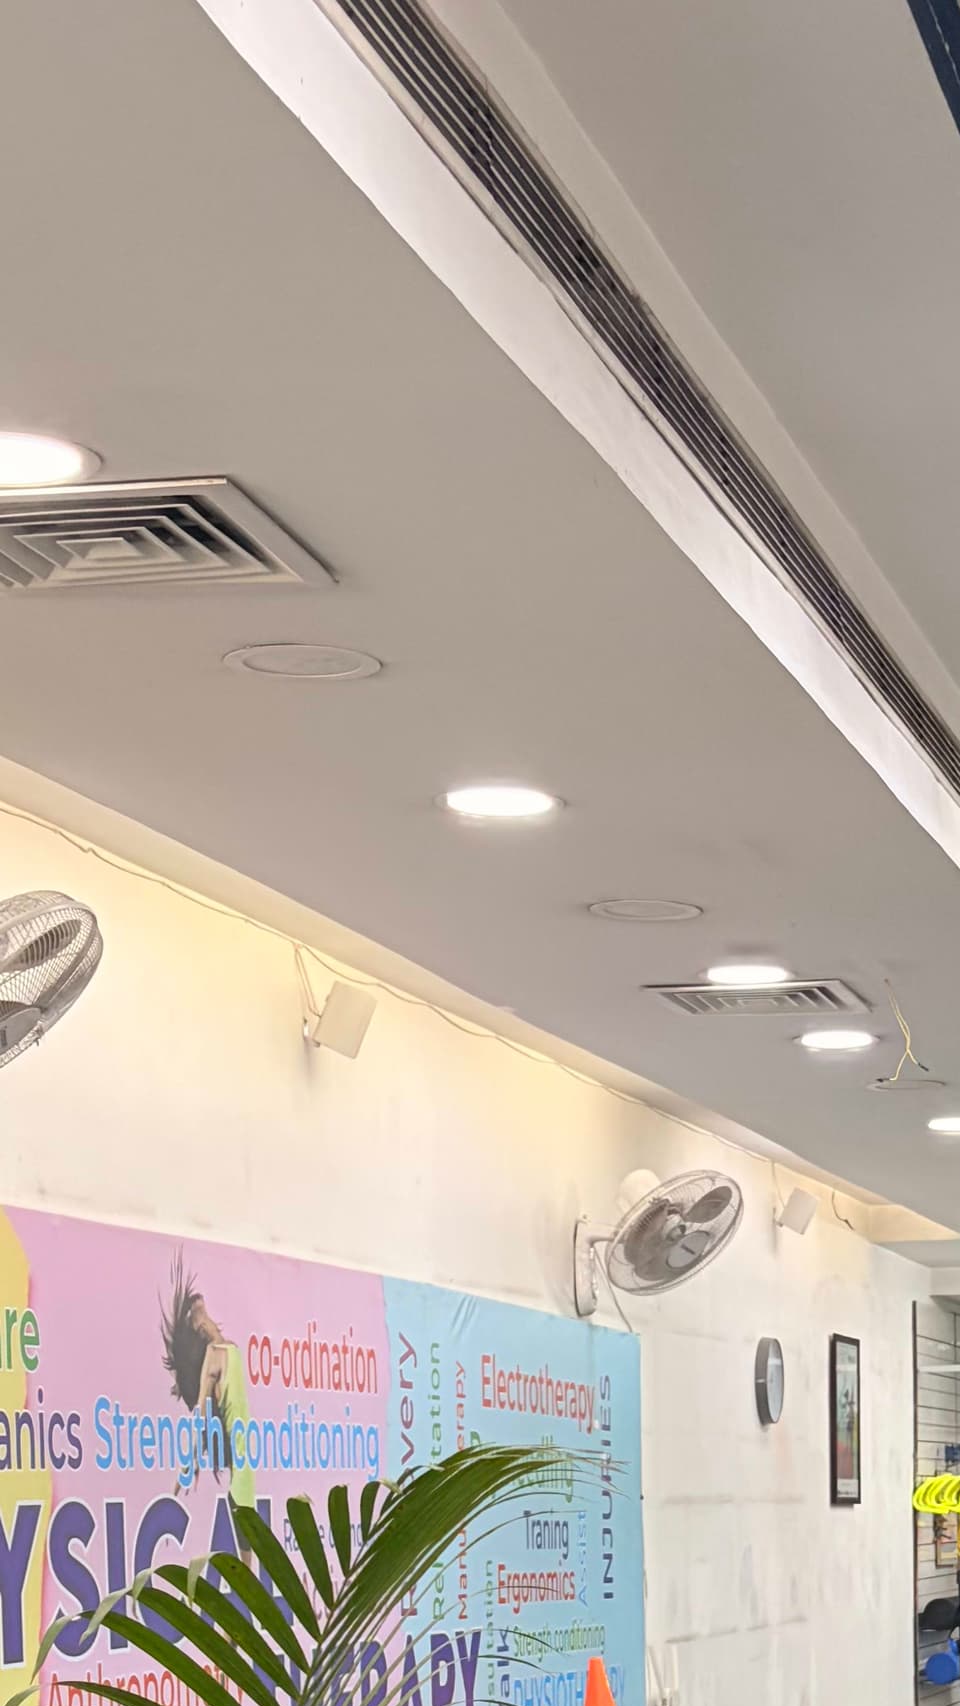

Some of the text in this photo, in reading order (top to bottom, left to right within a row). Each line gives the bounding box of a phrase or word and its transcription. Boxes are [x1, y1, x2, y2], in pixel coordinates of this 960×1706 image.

[248, 1321, 379, 1394] co-ordination
[481, 1353, 595, 1434] Electrotherapy
[94, 1396, 226, 1487] Strength
[230, 1401, 380, 1482] conditioning
[523, 1510, 569, 1560] Traning
[498, 1559, 576, 1615] Ergonomics
